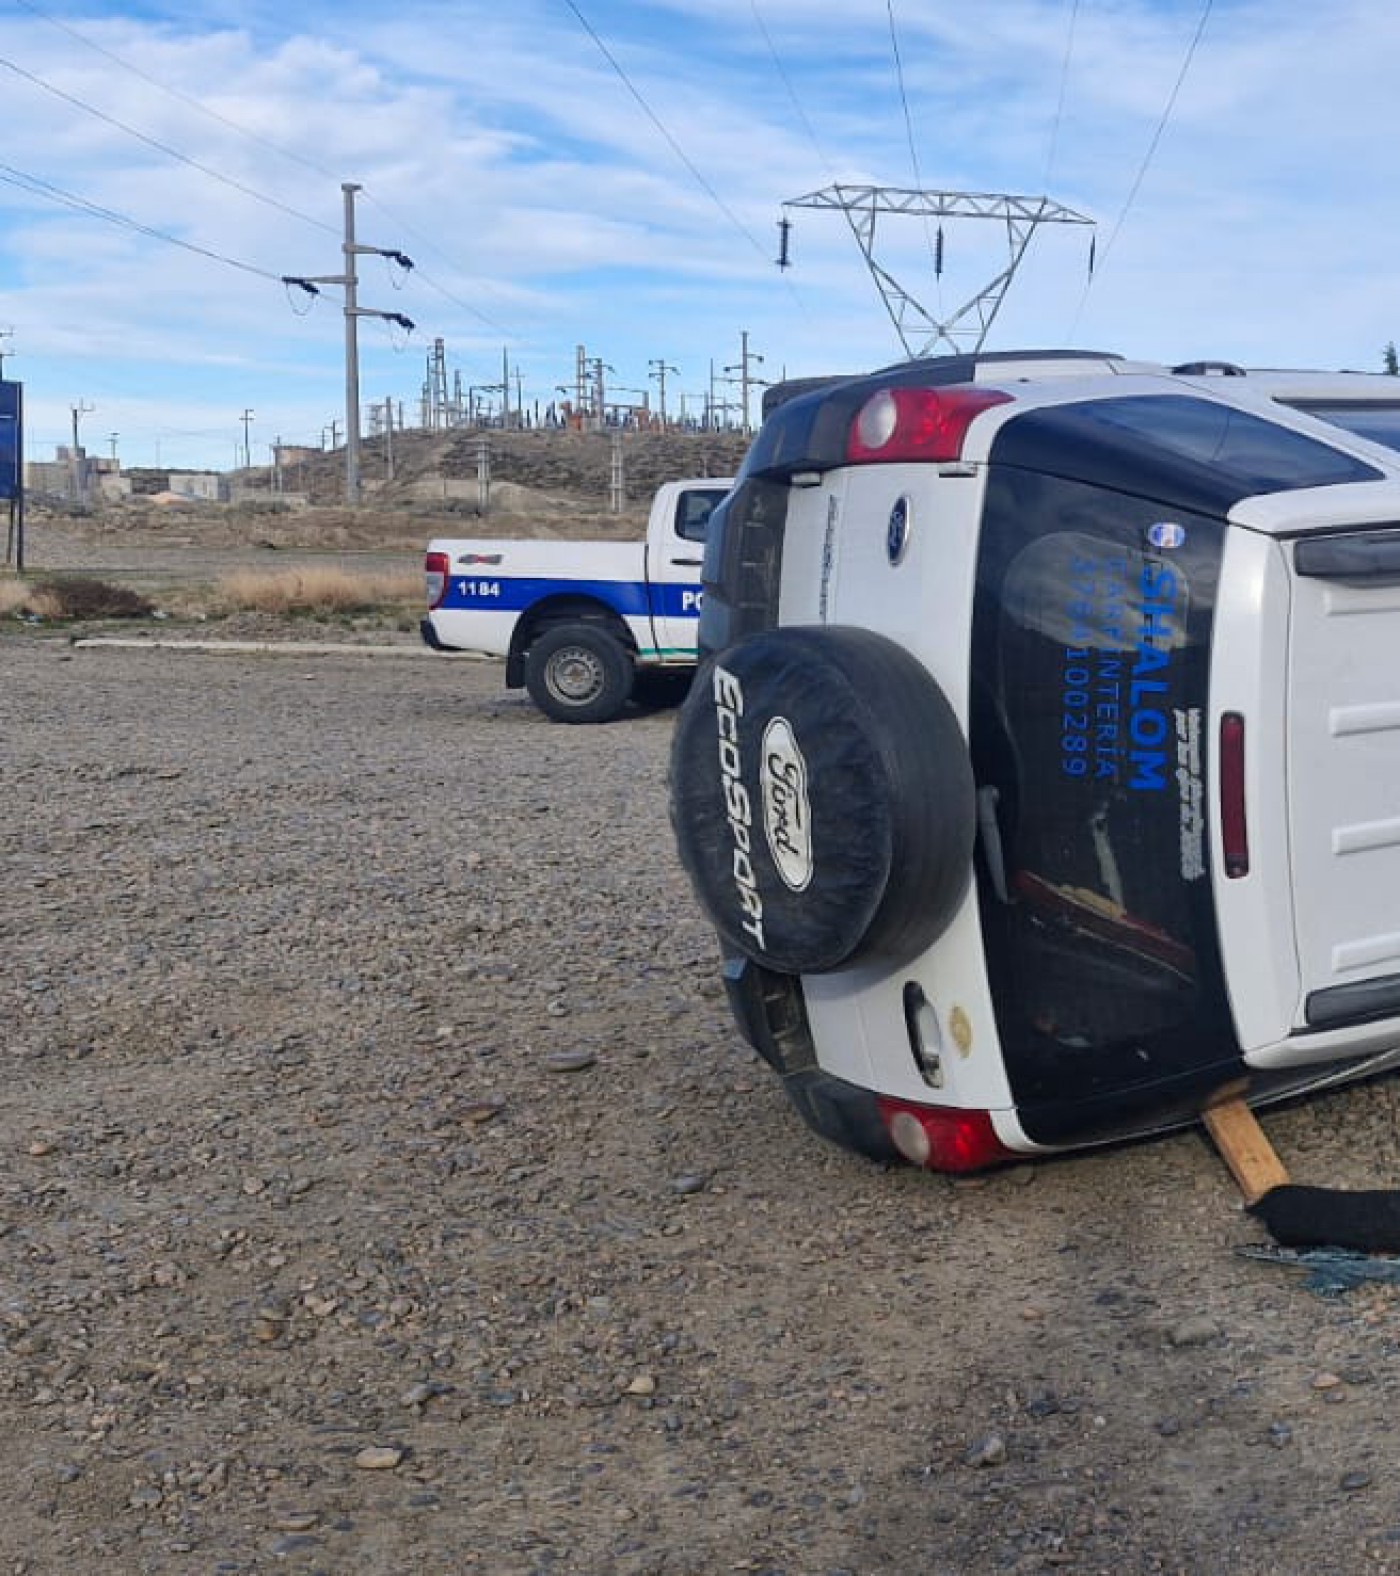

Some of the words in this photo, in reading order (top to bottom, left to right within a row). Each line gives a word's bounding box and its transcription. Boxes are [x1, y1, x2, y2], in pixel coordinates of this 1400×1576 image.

[457, 580, 501, 597] 1184
[1128, 568, 1178, 790] SHALOM
[713, 665, 766, 951] ECOSPORT
[766, 752, 801, 856] Ford
